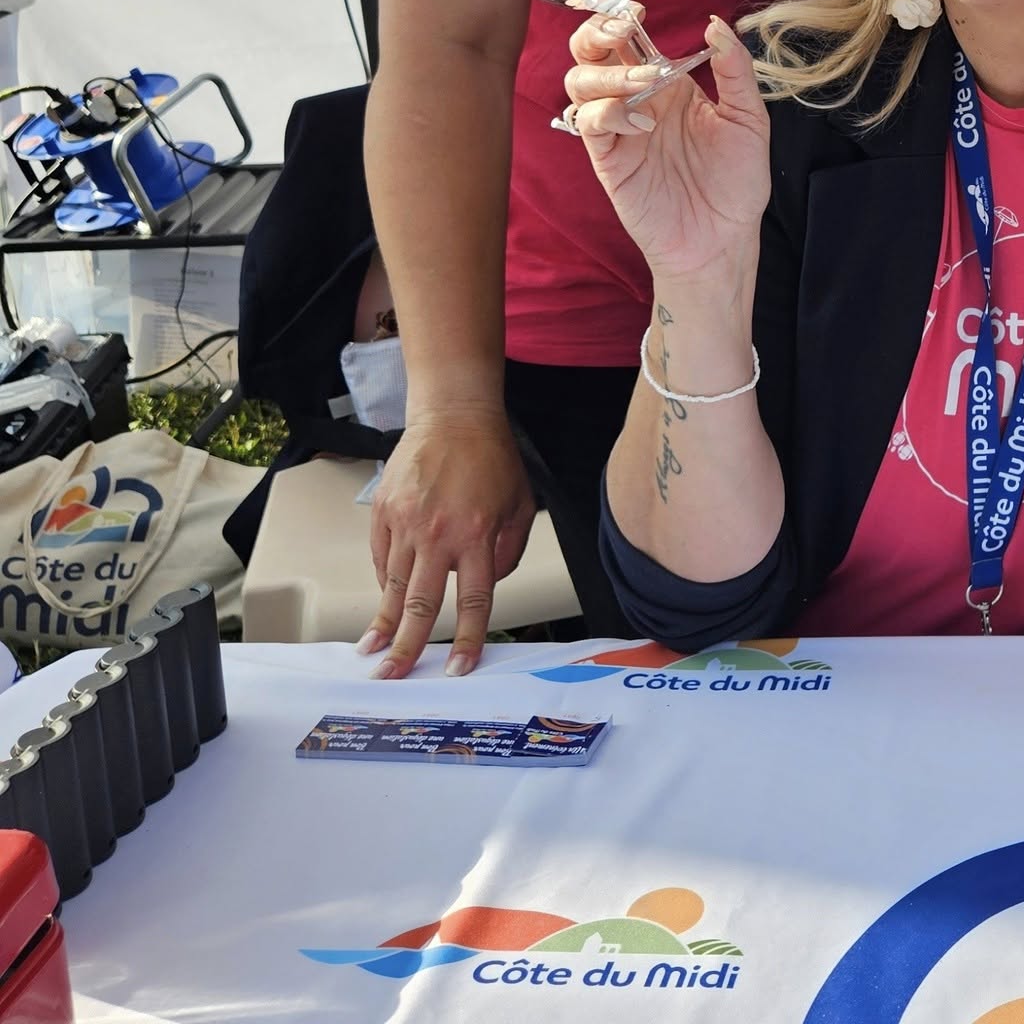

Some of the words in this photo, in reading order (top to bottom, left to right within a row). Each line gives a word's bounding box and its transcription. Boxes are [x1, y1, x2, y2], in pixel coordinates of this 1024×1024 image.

[952, 51, 968, 83] du
[953, 87, 979, 148] Côte
[971, 366, 994, 431] Côte
[972, 439, 995, 471] du
[981, 498, 1014, 552] Côte
[998, 459, 1024, 492] du
[1, 555, 85, 581] Côte
[94, 553, 137, 580] du
[623, 672, 702, 691] Côte
[709, 675, 751, 692] du
[400, 742, 422, 750] pour
[422, 744, 439, 752] Bon
[473, 745, 494, 753] pour
[495, 747, 512, 756] Bon
[472, 958, 572, 987] Côte
[582, 961, 636, 989] du
